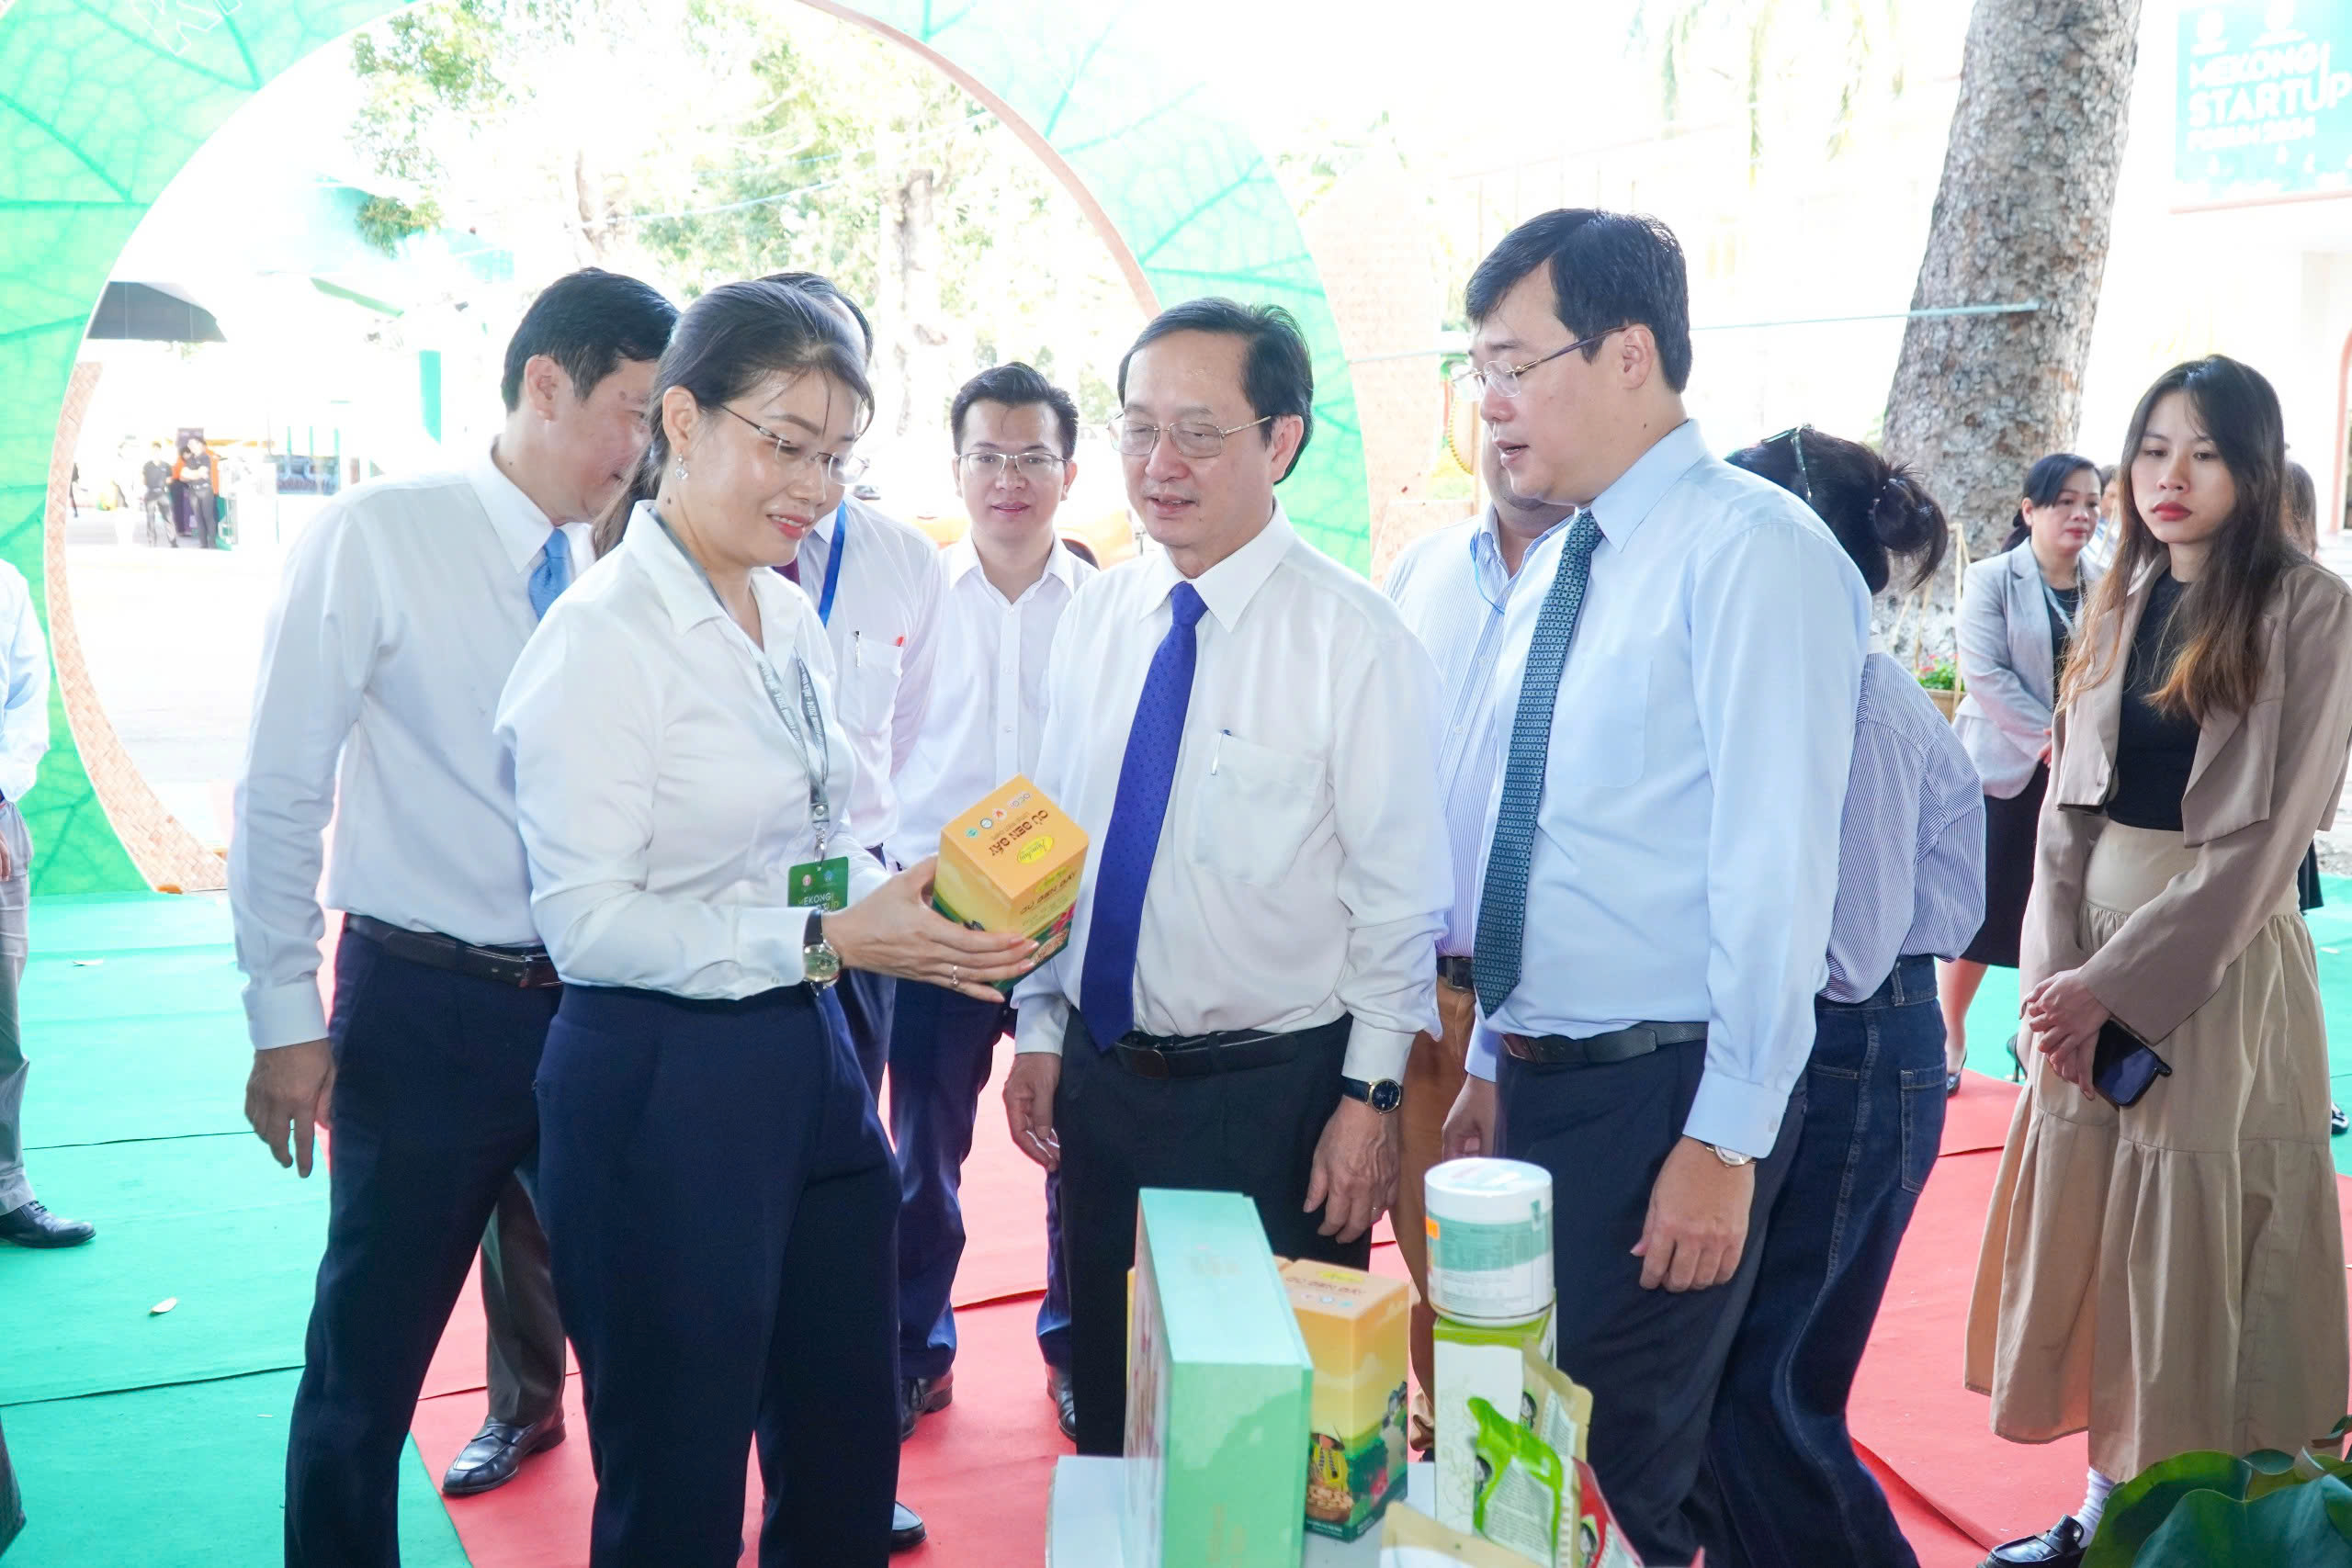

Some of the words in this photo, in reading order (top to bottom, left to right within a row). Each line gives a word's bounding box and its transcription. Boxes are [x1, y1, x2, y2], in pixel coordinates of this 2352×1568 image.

[2188, 40, 2352, 127] STARTUP
[2189, 43, 2318, 89] MEKONG
[806, 701, 818, 716] 2024
